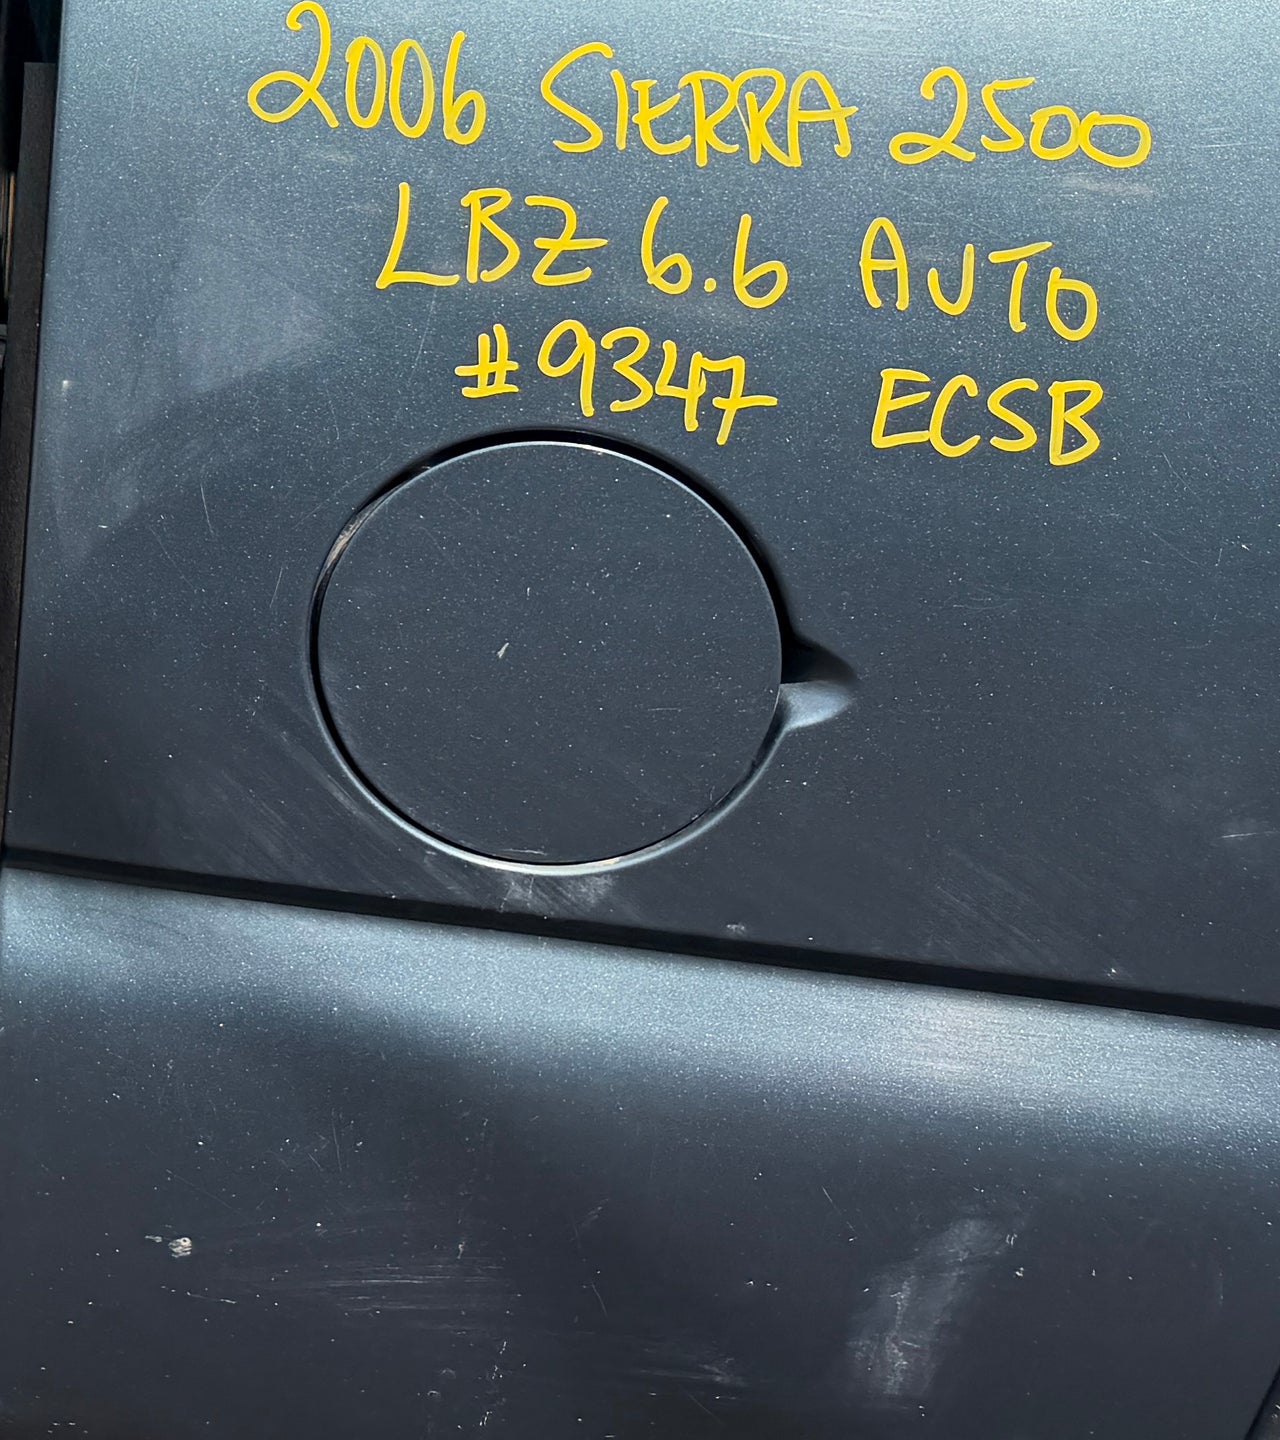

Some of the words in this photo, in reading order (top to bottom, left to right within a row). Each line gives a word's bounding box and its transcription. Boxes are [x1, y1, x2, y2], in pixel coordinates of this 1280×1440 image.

[248, 0, 487, 146] 2006
[541, 41, 858, 168] SIERRA
[889, 66, 1153, 169] 2500
[376, 182, 608, 290] LBZ
[640, 196, 789, 309] 6.6
[860, 217, 1100, 342] AUTO
[456, 319, 779, 446] #9347
[871, 368, 1104, 467] ECSB
